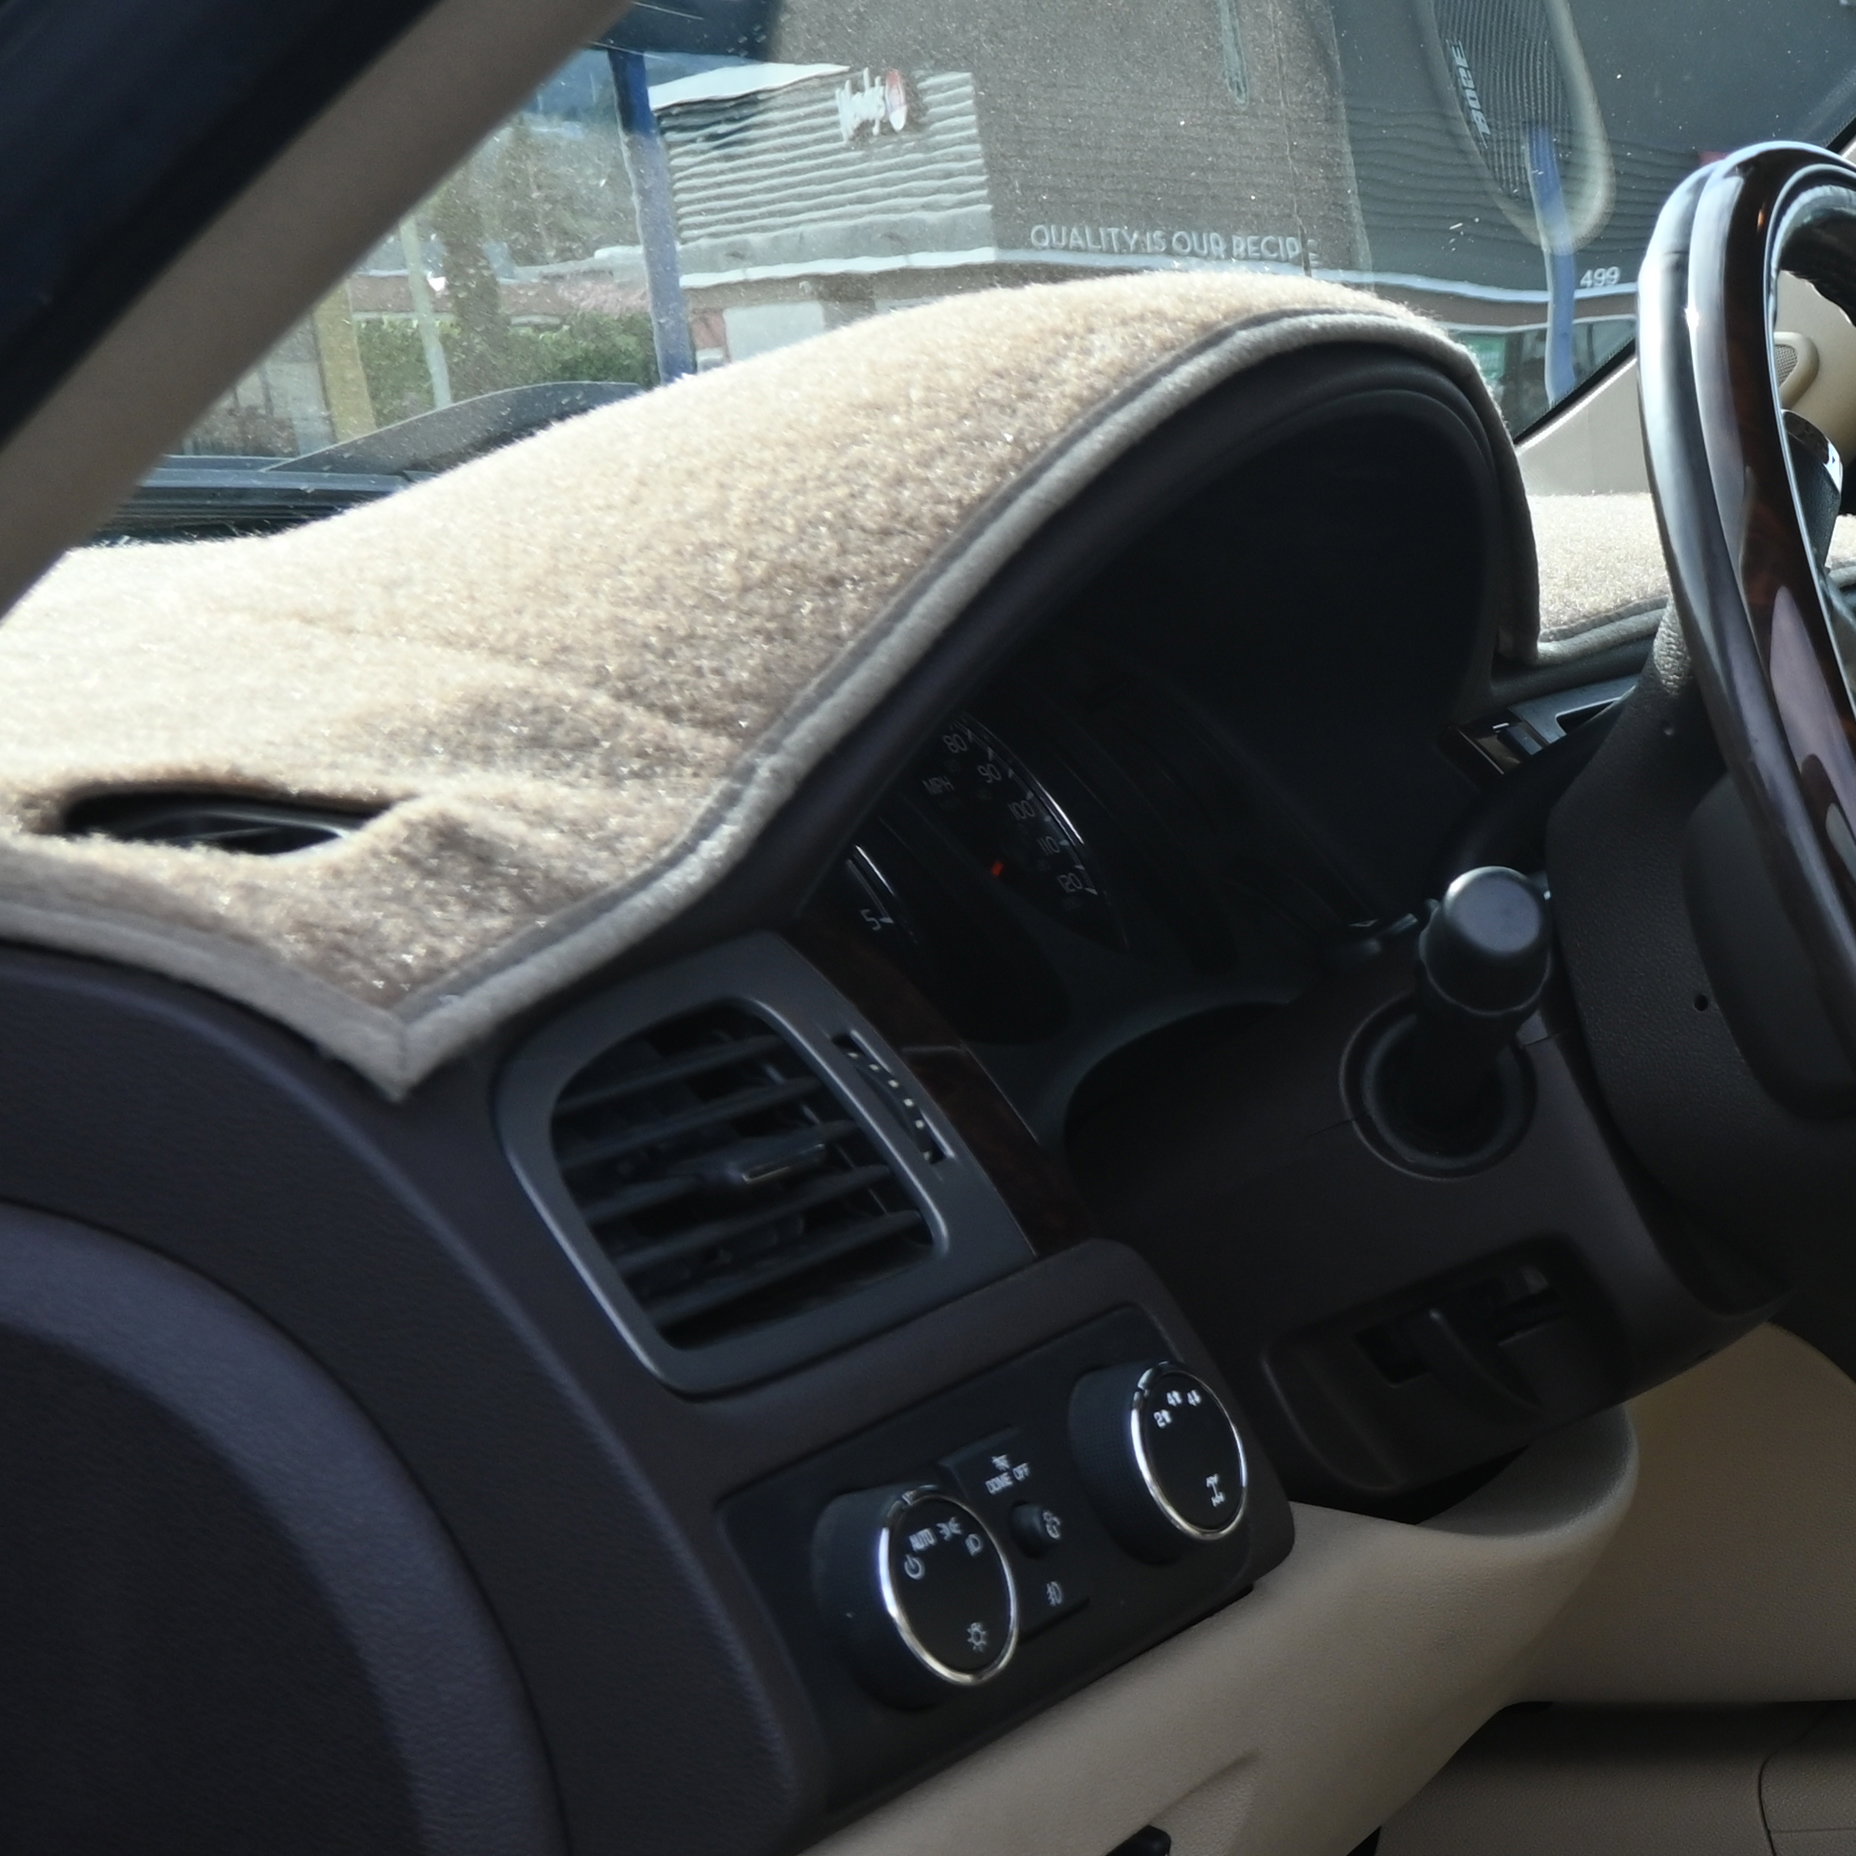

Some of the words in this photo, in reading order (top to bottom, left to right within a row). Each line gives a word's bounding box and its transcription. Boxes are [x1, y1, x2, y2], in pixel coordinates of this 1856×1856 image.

[1030, 223, 1139, 253] QUALITY
[1145, 229, 1168, 254] IS
[1171, 231, 1226, 260] OUR
[1580, 266, 1620, 289] 499
[977, 763, 1002, 784] 90
[1008, 799, 1036, 821] 100
[985, 1471, 1014, 1496] DOME
[1012, 1462, 1031, 1482] OFF
[908, 1528, 937, 1553] AUTO
